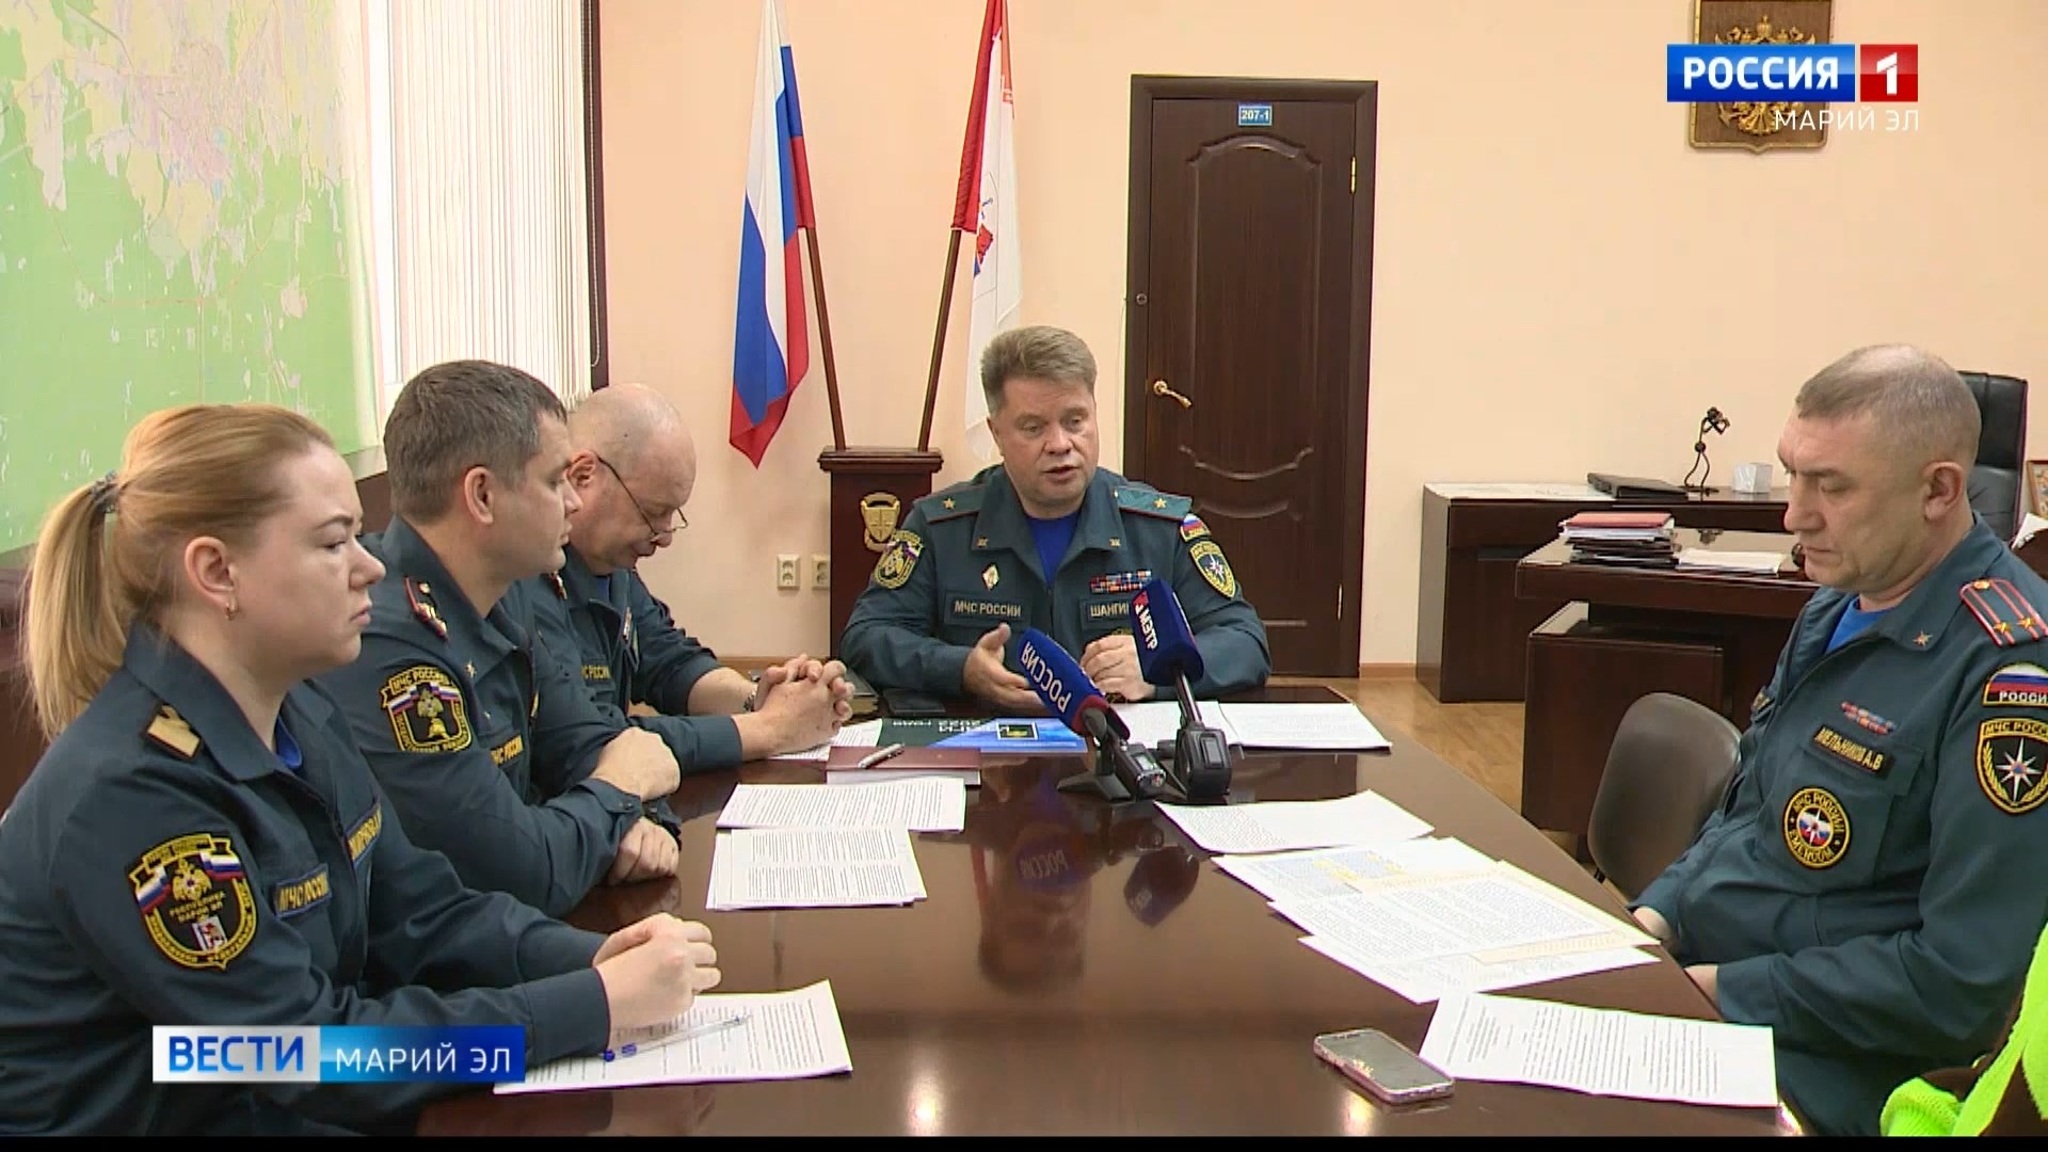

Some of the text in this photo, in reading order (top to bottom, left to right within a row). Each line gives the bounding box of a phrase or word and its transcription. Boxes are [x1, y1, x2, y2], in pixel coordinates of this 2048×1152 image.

[1241, 109, 1270, 122] 207-1
[954, 600, 1022, 617] МЧС РОССИИ
[1021, 641, 1072, 713] РОССИЯ
[1984, 722, 2011, 736] МЧС
